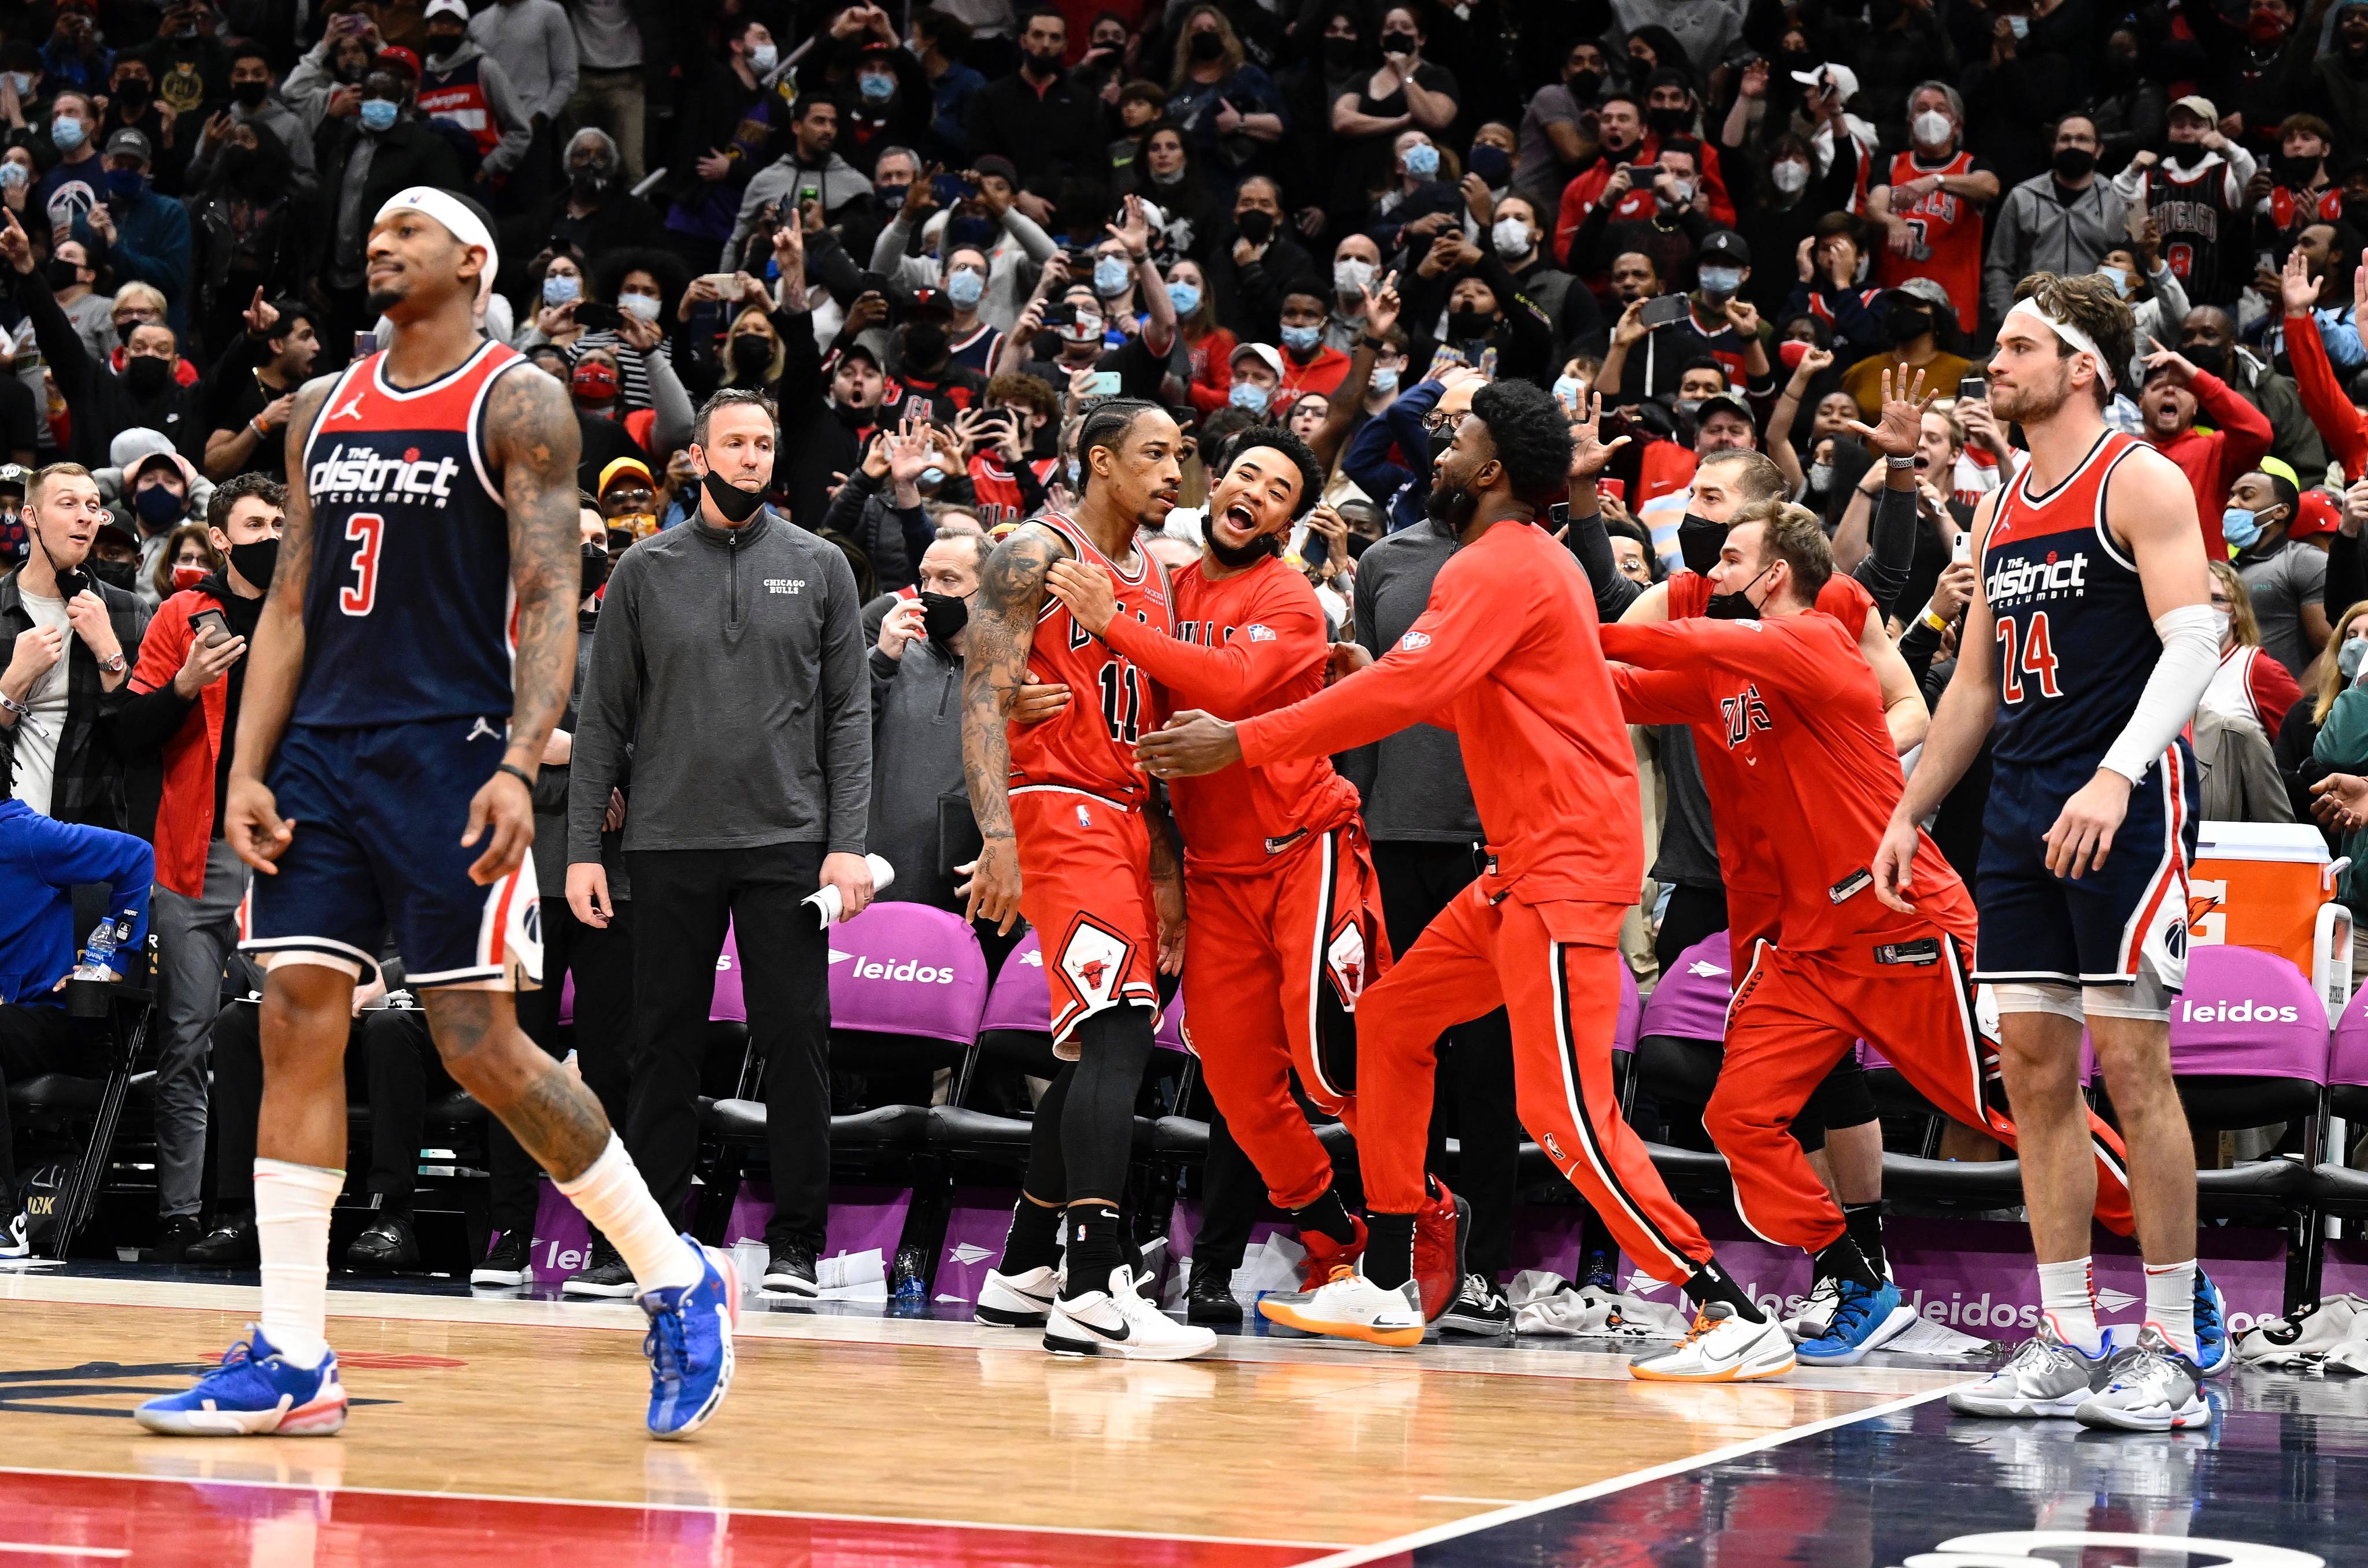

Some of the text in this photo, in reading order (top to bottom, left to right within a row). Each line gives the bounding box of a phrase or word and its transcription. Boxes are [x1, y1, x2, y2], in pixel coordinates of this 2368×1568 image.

[347, 447, 373, 460] THE
[309, 443, 460, 496] district
[329, 492, 447, 509] COLUMBIA
[339, 512, 384, 616] 3
[2007, 557, 2025, 569] THE
[763, 579, 805, 588] CHICAGO
[1986, 551, 2088, 605] district
[769, 586, 799, 595] BULLS
[1998, 588, 2084, 609] COLUMBIA
[1996, 610, 2064, 705] 24
[1098, 660, 1140, 746] 11
[86, 949, 105, 962] QUAFINA
[853, 955, 954, 984] leidos
[2182, 999, 2299, 1023] leidos
[1912, 1289, 2039, 1328] leidos
